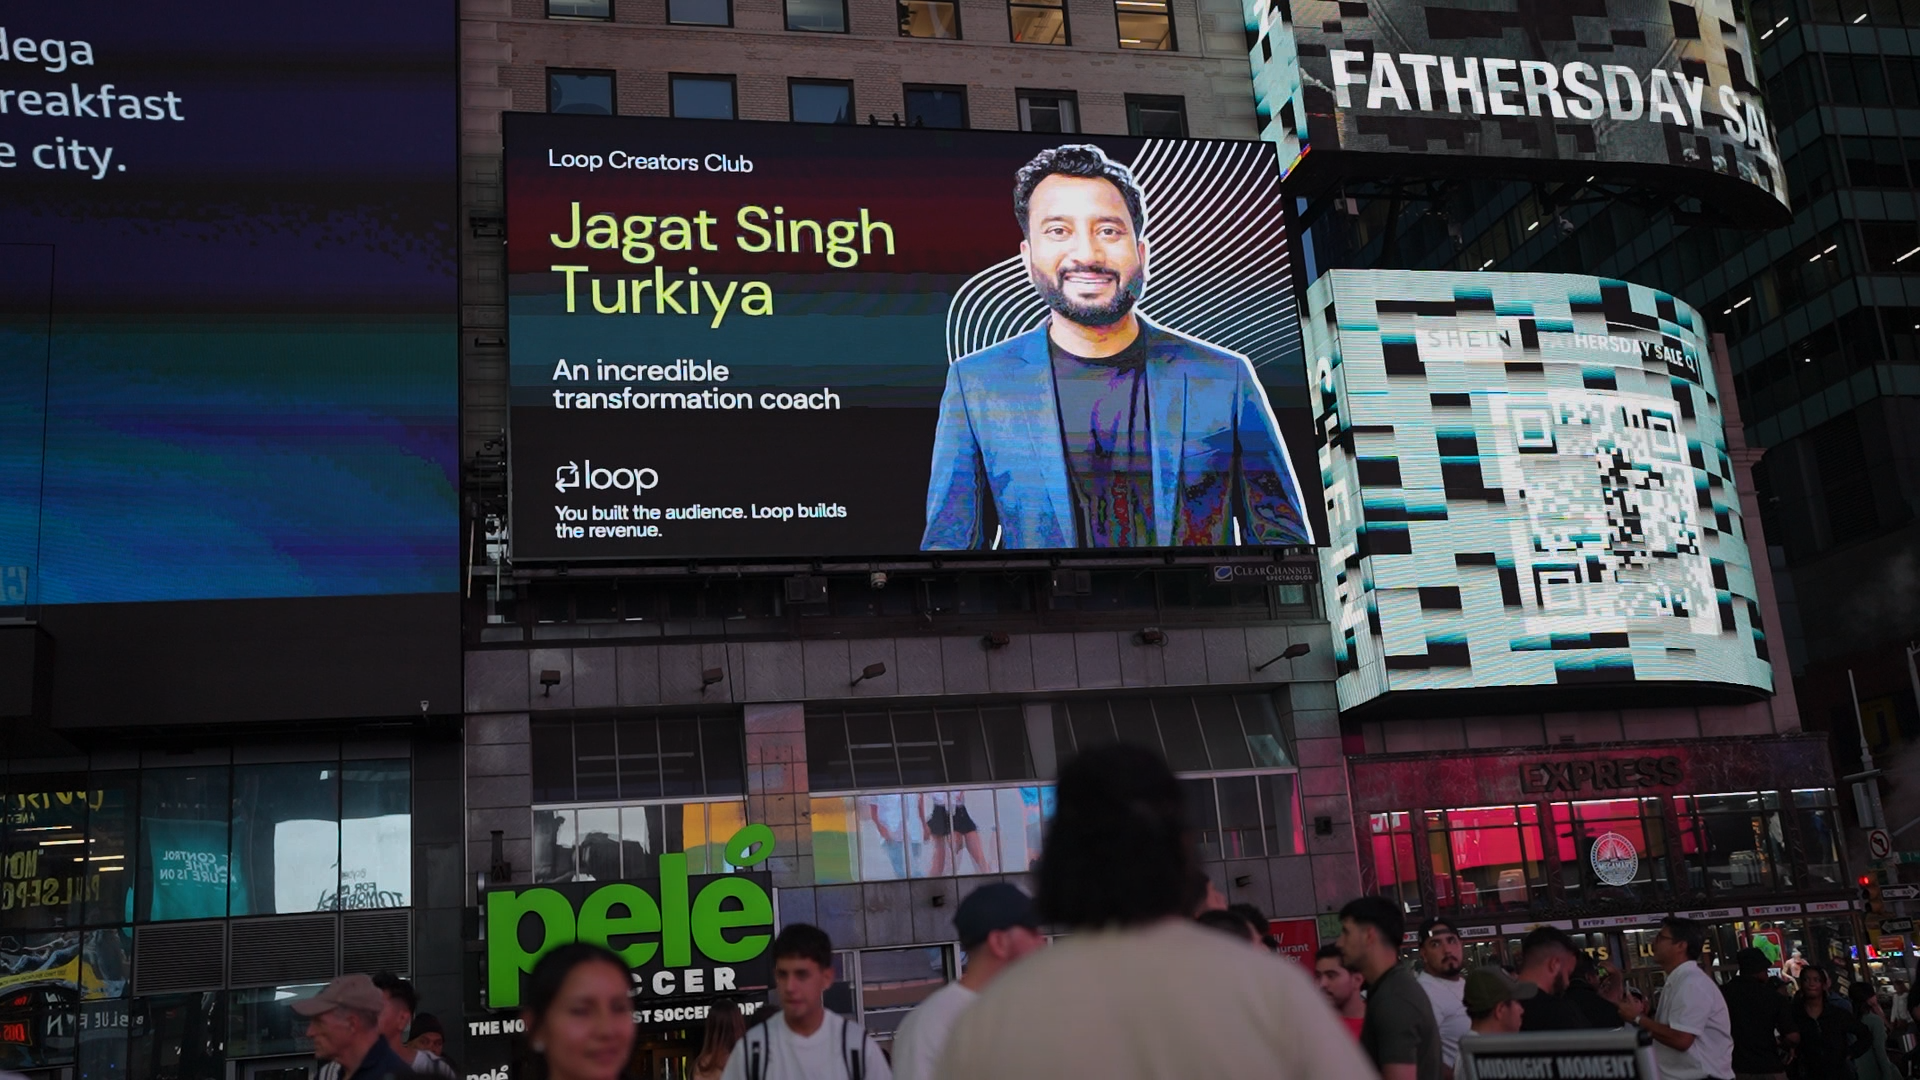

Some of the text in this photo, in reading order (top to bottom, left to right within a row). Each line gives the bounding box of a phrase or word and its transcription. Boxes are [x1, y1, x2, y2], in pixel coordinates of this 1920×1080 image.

[1330, 49, 1704, 130] FATHERSDAY
[32, 136, 127, 180] city.
[548, 149, 754, 173] Loop Creators Club
[550, 202, 895, 268] Jagat Singh
[551, 265, 773, 329] Turkiya
[1653, 343, 1684, 367] SALE
[553, 358, 729, 382] An incredible
[553, 387, 841, 410] transformation coach
[585, 460, 659, 496] loop
[555, 503, 847, 522] You built the audience. Loop builds
[555, 522, 663, 539] the revenue.
[1519, 756, 1684, 794] EXPRESS
[487, 823, 776, 1008] pelé
[469, 1020, 501, 1036] THE
[1476, 1055, 1636, 1080] MIDNIGHT MOMENT
